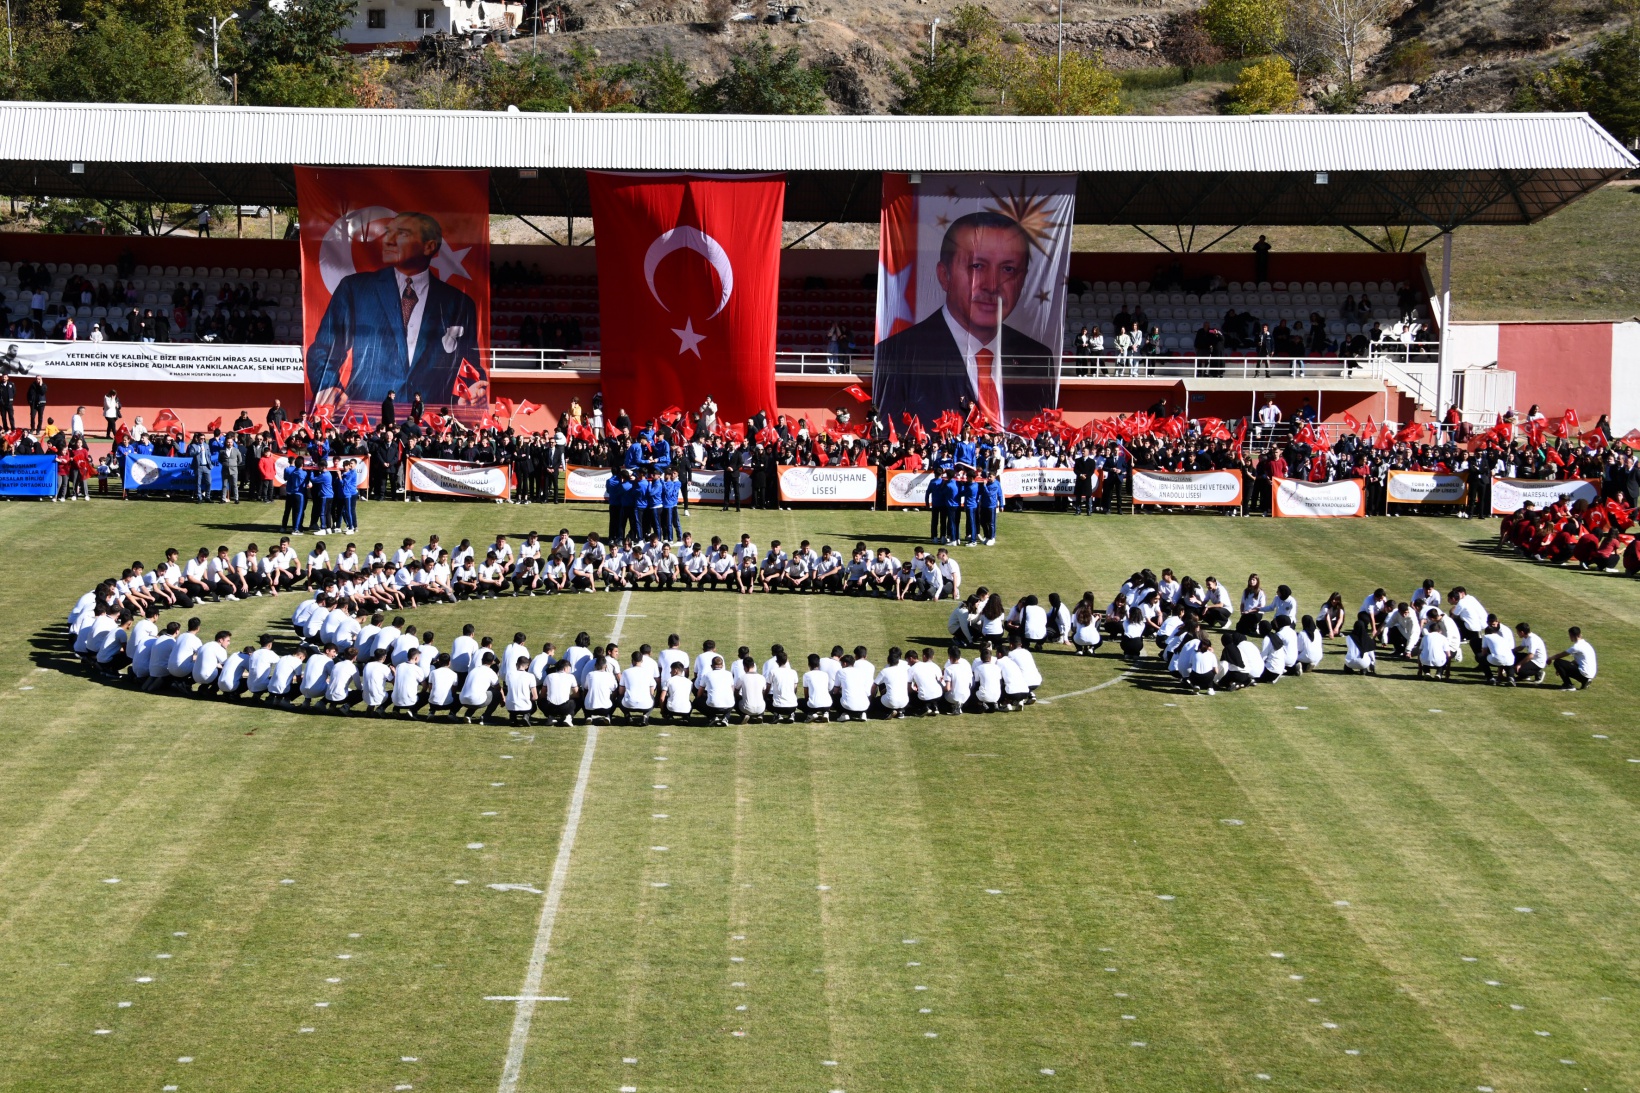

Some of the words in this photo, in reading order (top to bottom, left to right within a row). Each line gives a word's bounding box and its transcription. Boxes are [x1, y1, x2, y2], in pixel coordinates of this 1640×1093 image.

[66, 351, 108, 360] YETENEĞİN
[121, 352, 158, 361] KALBİNLE
[222, 355, 247, 363] MİRAS
[107, 361, 150, 369] KÖŞESİNDE
[812, 472, 867, 484] GÜMÜŞHANE
[812, 485, 837, 495] LİSESİ
